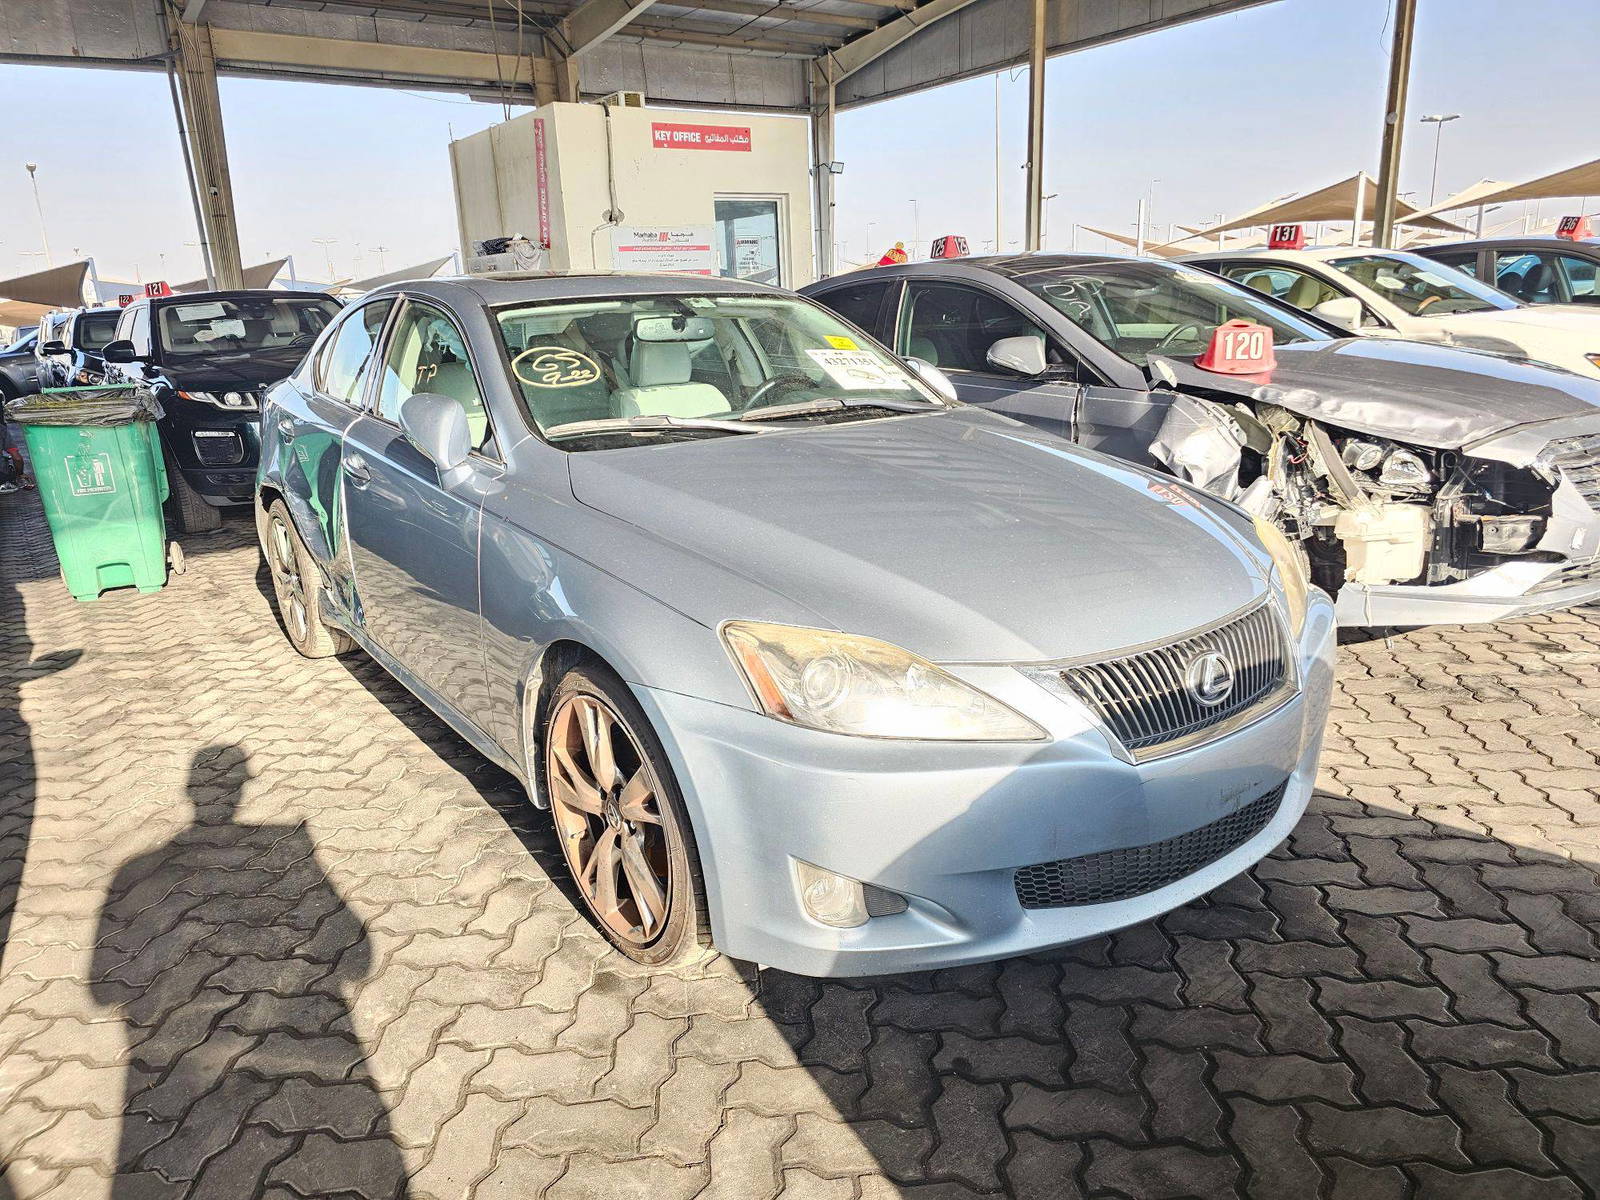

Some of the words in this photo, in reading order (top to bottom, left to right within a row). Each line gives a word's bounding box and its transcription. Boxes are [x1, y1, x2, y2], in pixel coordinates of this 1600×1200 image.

[654, 130, 671, 141] KEY
[673, 131, 701, 143] OFFICE
[730, 134, 750, 144] مكتب
[1275, 225, 1297, 241] 131
[148, 282, 163, 296] 121
[1224, 332, 1264, 360] 120
